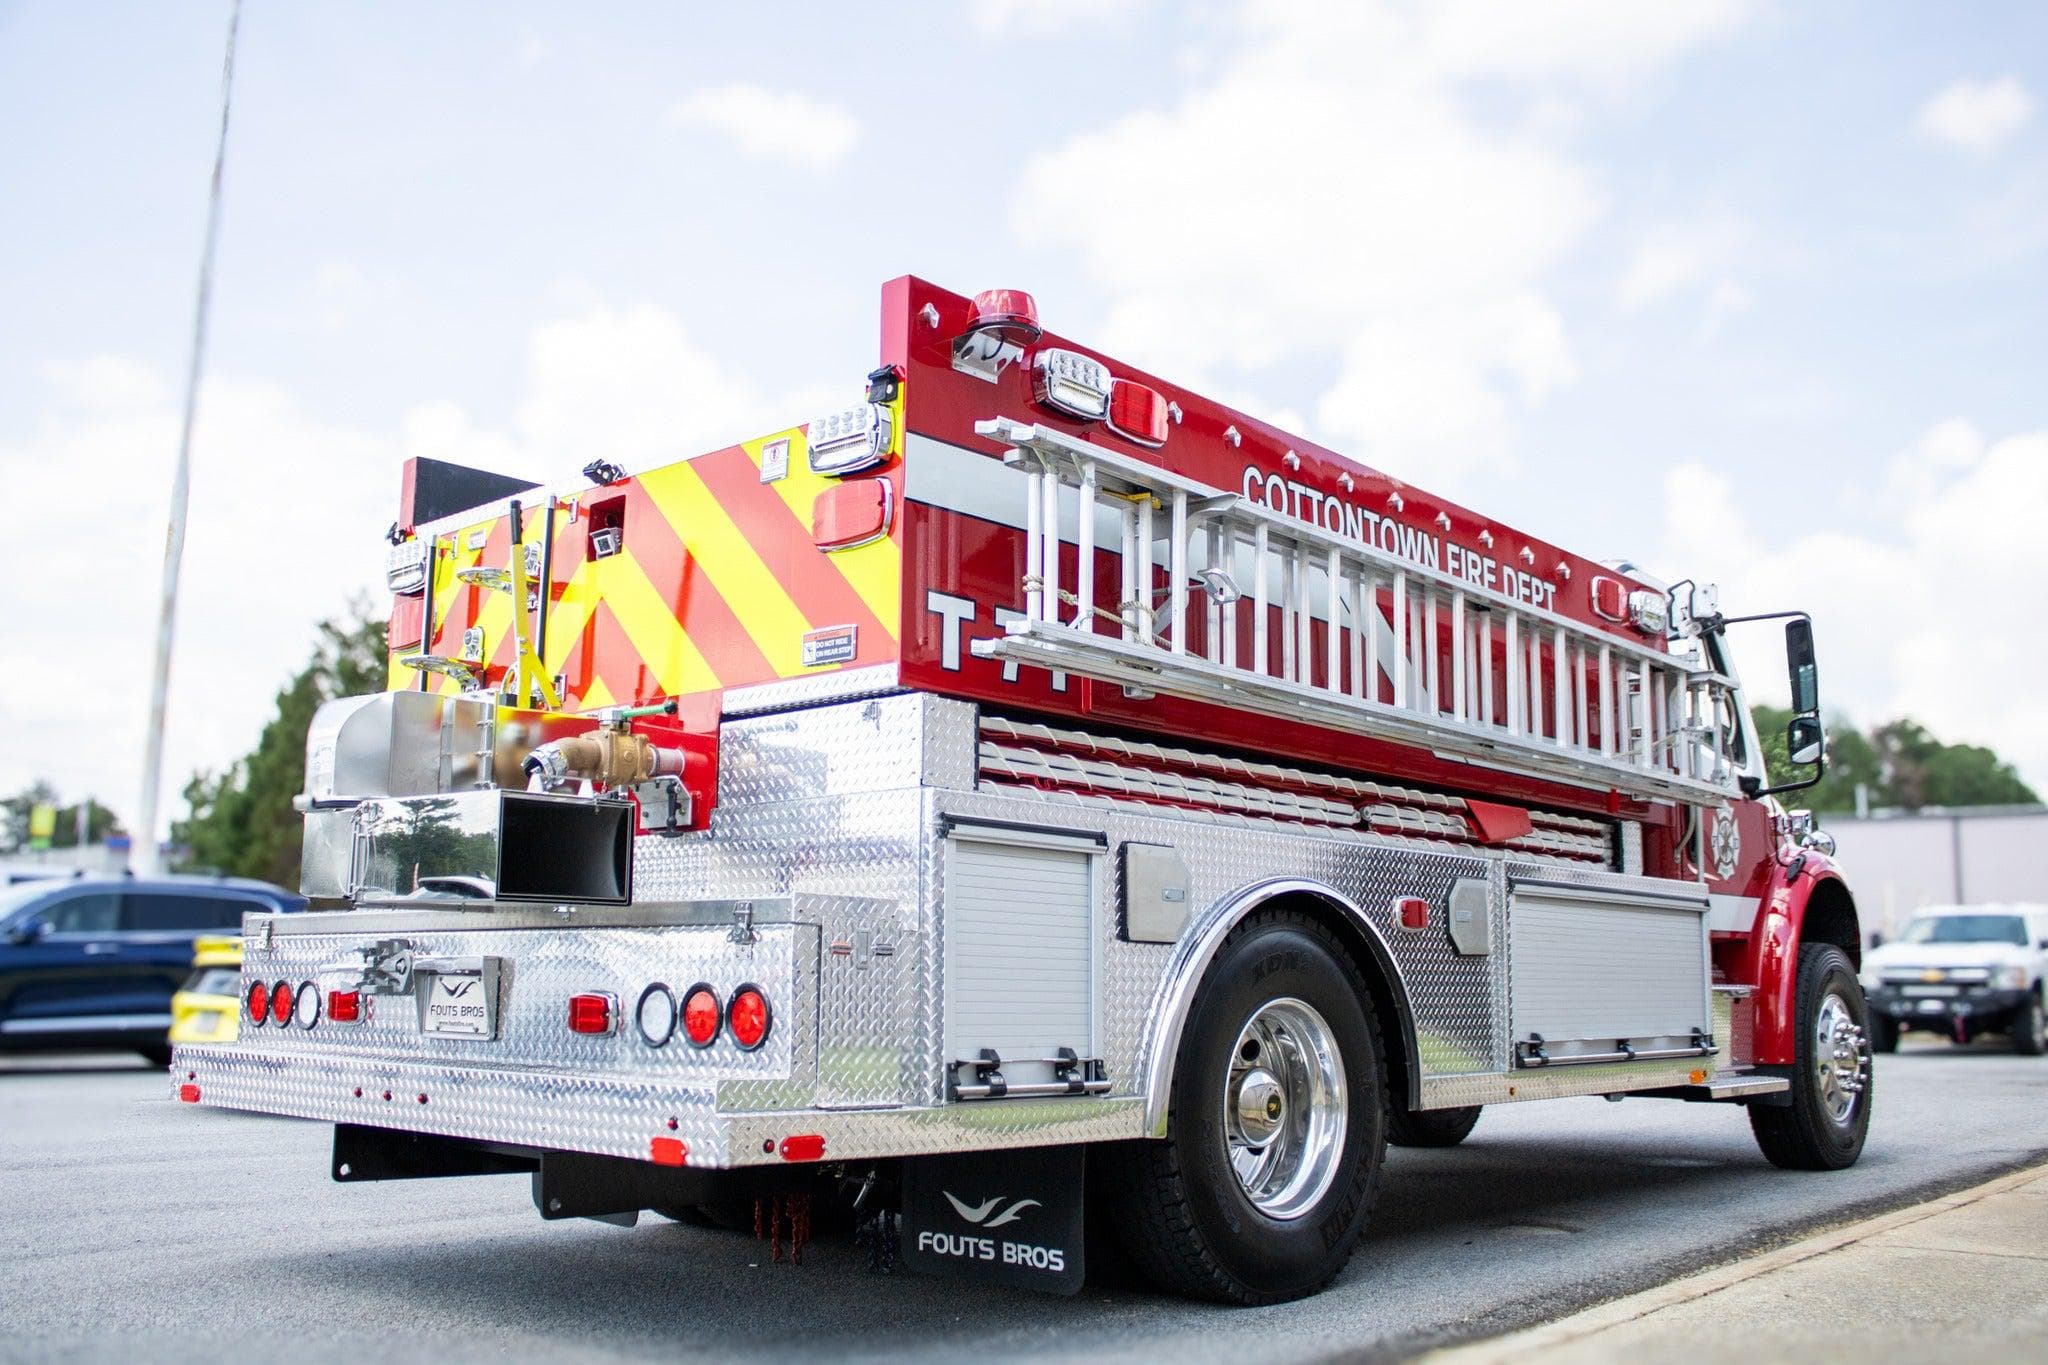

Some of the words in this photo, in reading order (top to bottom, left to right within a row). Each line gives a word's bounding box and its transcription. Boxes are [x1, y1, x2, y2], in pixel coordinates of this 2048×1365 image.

[1242, 465, 1440, 571] COTTONTOWN
[1446, 542, 1497, 590] FIRE
[1502, 565, 1557, 613] DEPT
[431, 1004, 458, 1017] FOUTS
[461, 1005, 485, 1018] BROS
[918, 1231, 996, 1261] FOUTS
[1002, 1241, 1065, 1272] BROS
